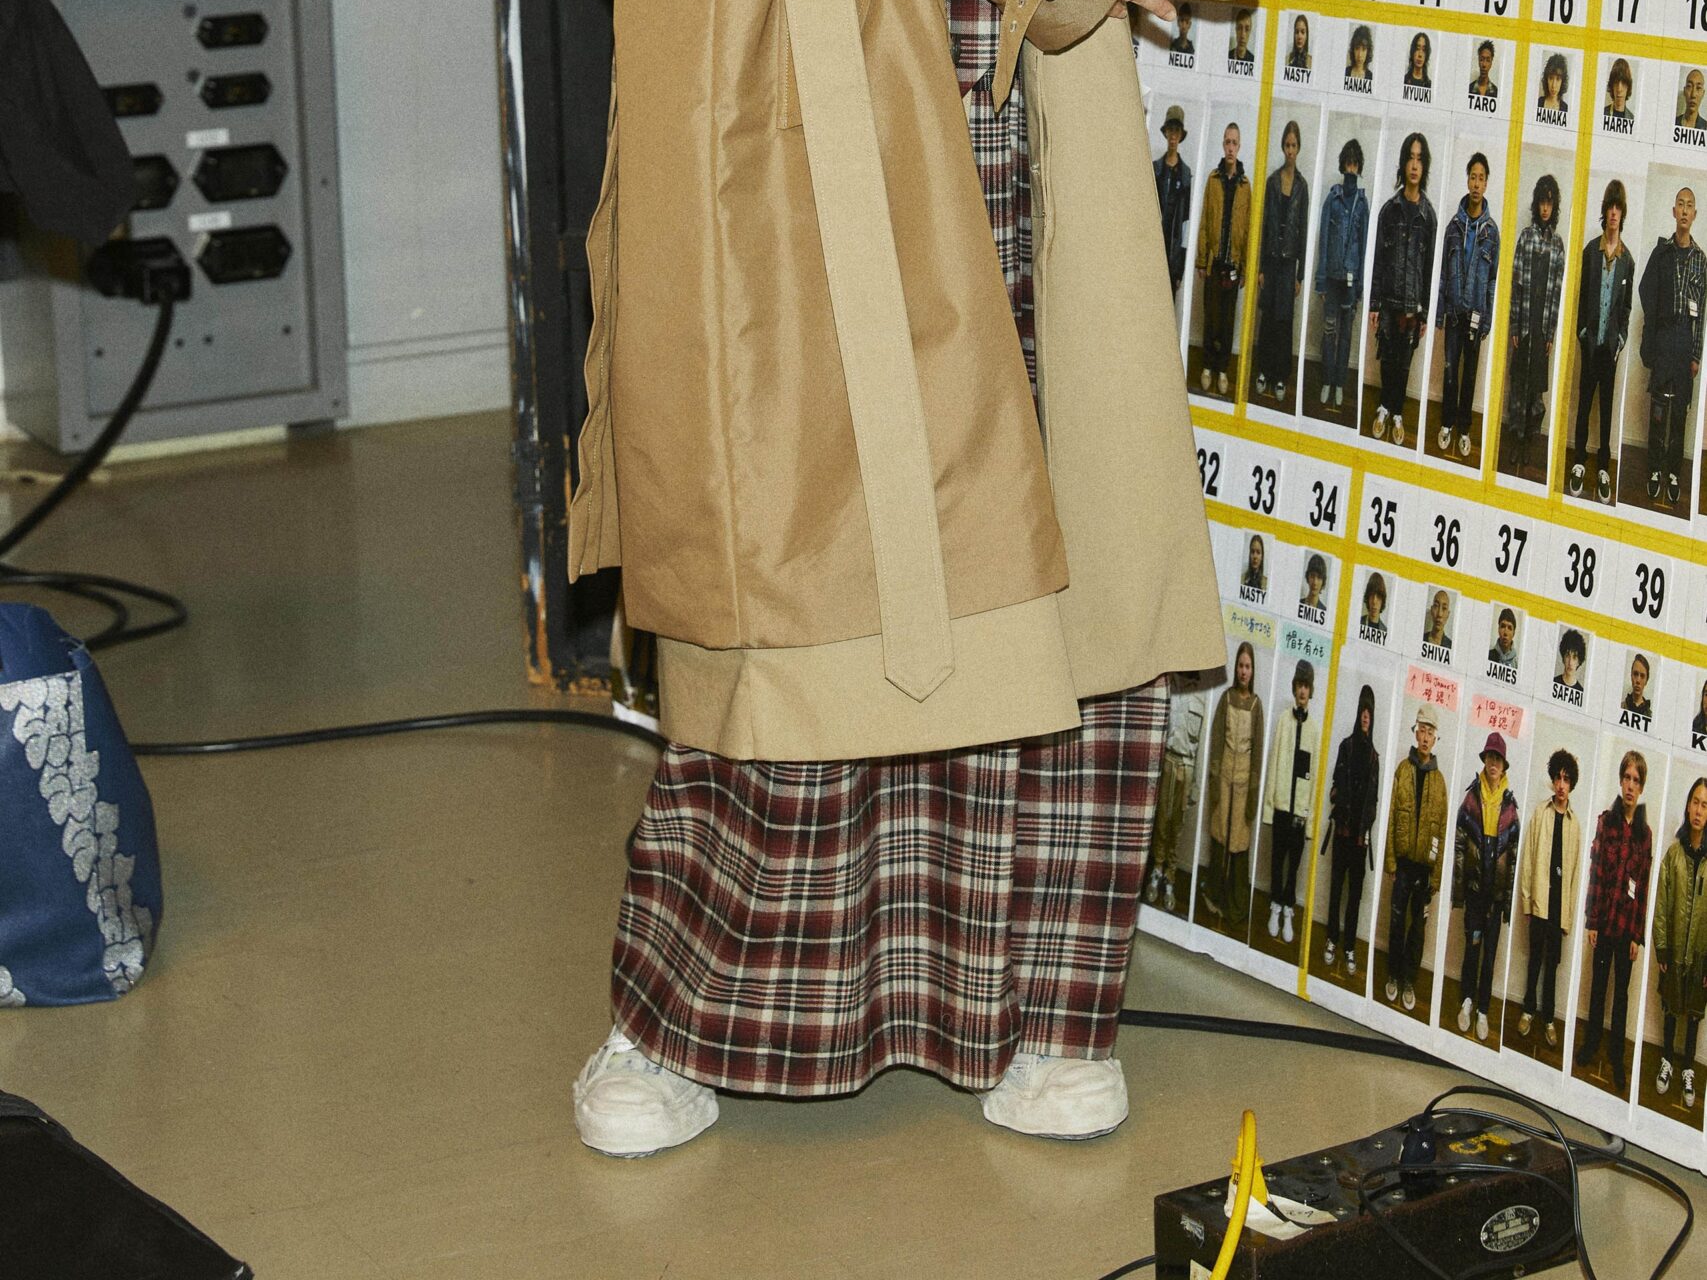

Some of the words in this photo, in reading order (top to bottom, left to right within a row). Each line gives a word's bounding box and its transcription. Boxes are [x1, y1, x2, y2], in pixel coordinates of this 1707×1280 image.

[1168, 52, 1195, 69] NELLO
[1227, 60, 1254, 77] VICTOR
[1283, 67, 1312, 84] NASTY
[1343, 76, 1372, 94] HANAKA
[1402, 85, 1432, 104] MYUUKI
[1468, 95, 1497, 113] TARO
[1536, 107, 1567, 127] HANAKA
[1603, 116, 1635, 135] HARRY
[1673, 127, 1706, 147] SHIVA
[1249, 465, 1276, 515] 33
[1309, 480, 1338, 532] 34
[1368, 496, 1397, 548] 35
[1430, 514, 1461, 568] 36
[1495, 524, 1528, 577] 37
[1564, 543, 1596, 598] 38
[1632, 563, 1665, 619] 39
[1239, 585, 1267, 605] NASTY
[1297, 604, 1325, 626] EMILS
[1359, 624, 1388, 646] HARRY
[1421, 643, 1450, 665] SHIVA
[1486, 662, 1517, 685] JAMES
[1552, 683, 1584, 708] SAFARI
[1618, 710, 1652, 733] ART
